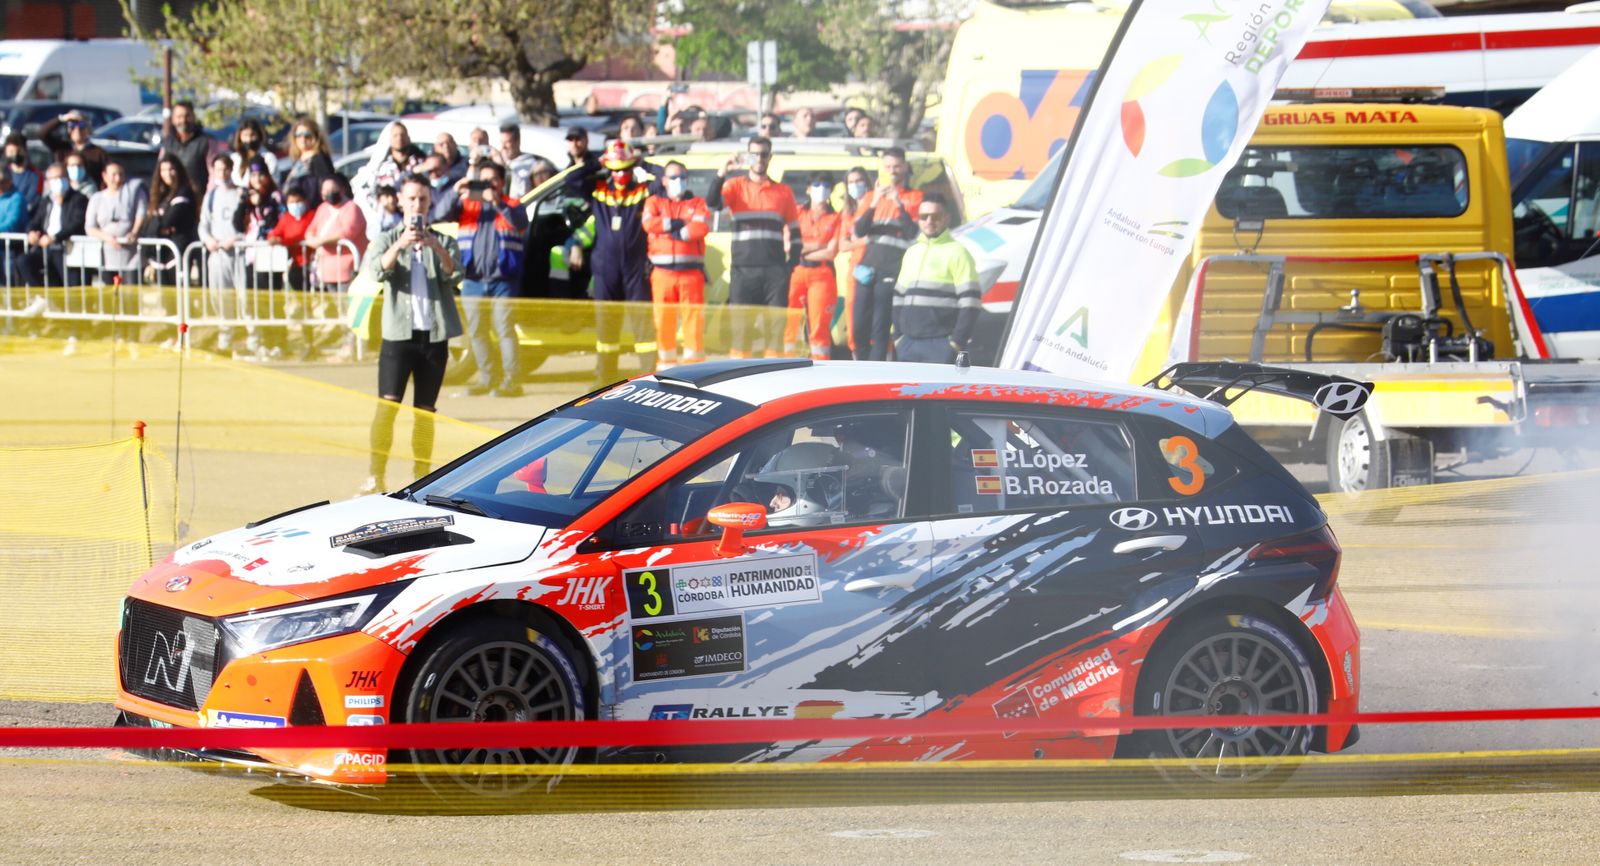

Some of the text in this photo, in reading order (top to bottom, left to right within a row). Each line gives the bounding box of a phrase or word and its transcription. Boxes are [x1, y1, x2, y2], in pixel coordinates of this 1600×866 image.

[1224, 1, 1272, 66] Región
[1264, 111, 1419, 126] GRUAS MATA
[1149, 238, 1175, 256] Europa
[624, 387, 723, 416] HYUNDAI
[1002, 448, 1089, 472] P.López
[1167, 435, 1205, 496] 3
[1005, 475, 1114, 496] B.Rozada
[1163, 504, 1295, 527] HYUNDAI
[729, 565, 803, 585] PATRIMONIO
[556, 576, 614, 605] JHK
[638, 571, 663, 616] 3
[678, 589, 725, 603] CÓRDOBA
[730, 577, 815, 598] HUMANIDAD
[705, 651, 743, 663] IMDECO
[345, 670, 383, 688] JHK
[1032, 648, 1113, 698] Comunidad
[1040, 660, 1120, 711] de Madrid
[348, 697, 382, 705] PHILIPS
[692, 706, 789, 719] RALLYE
[345, 752, 385, 766] PAGID
